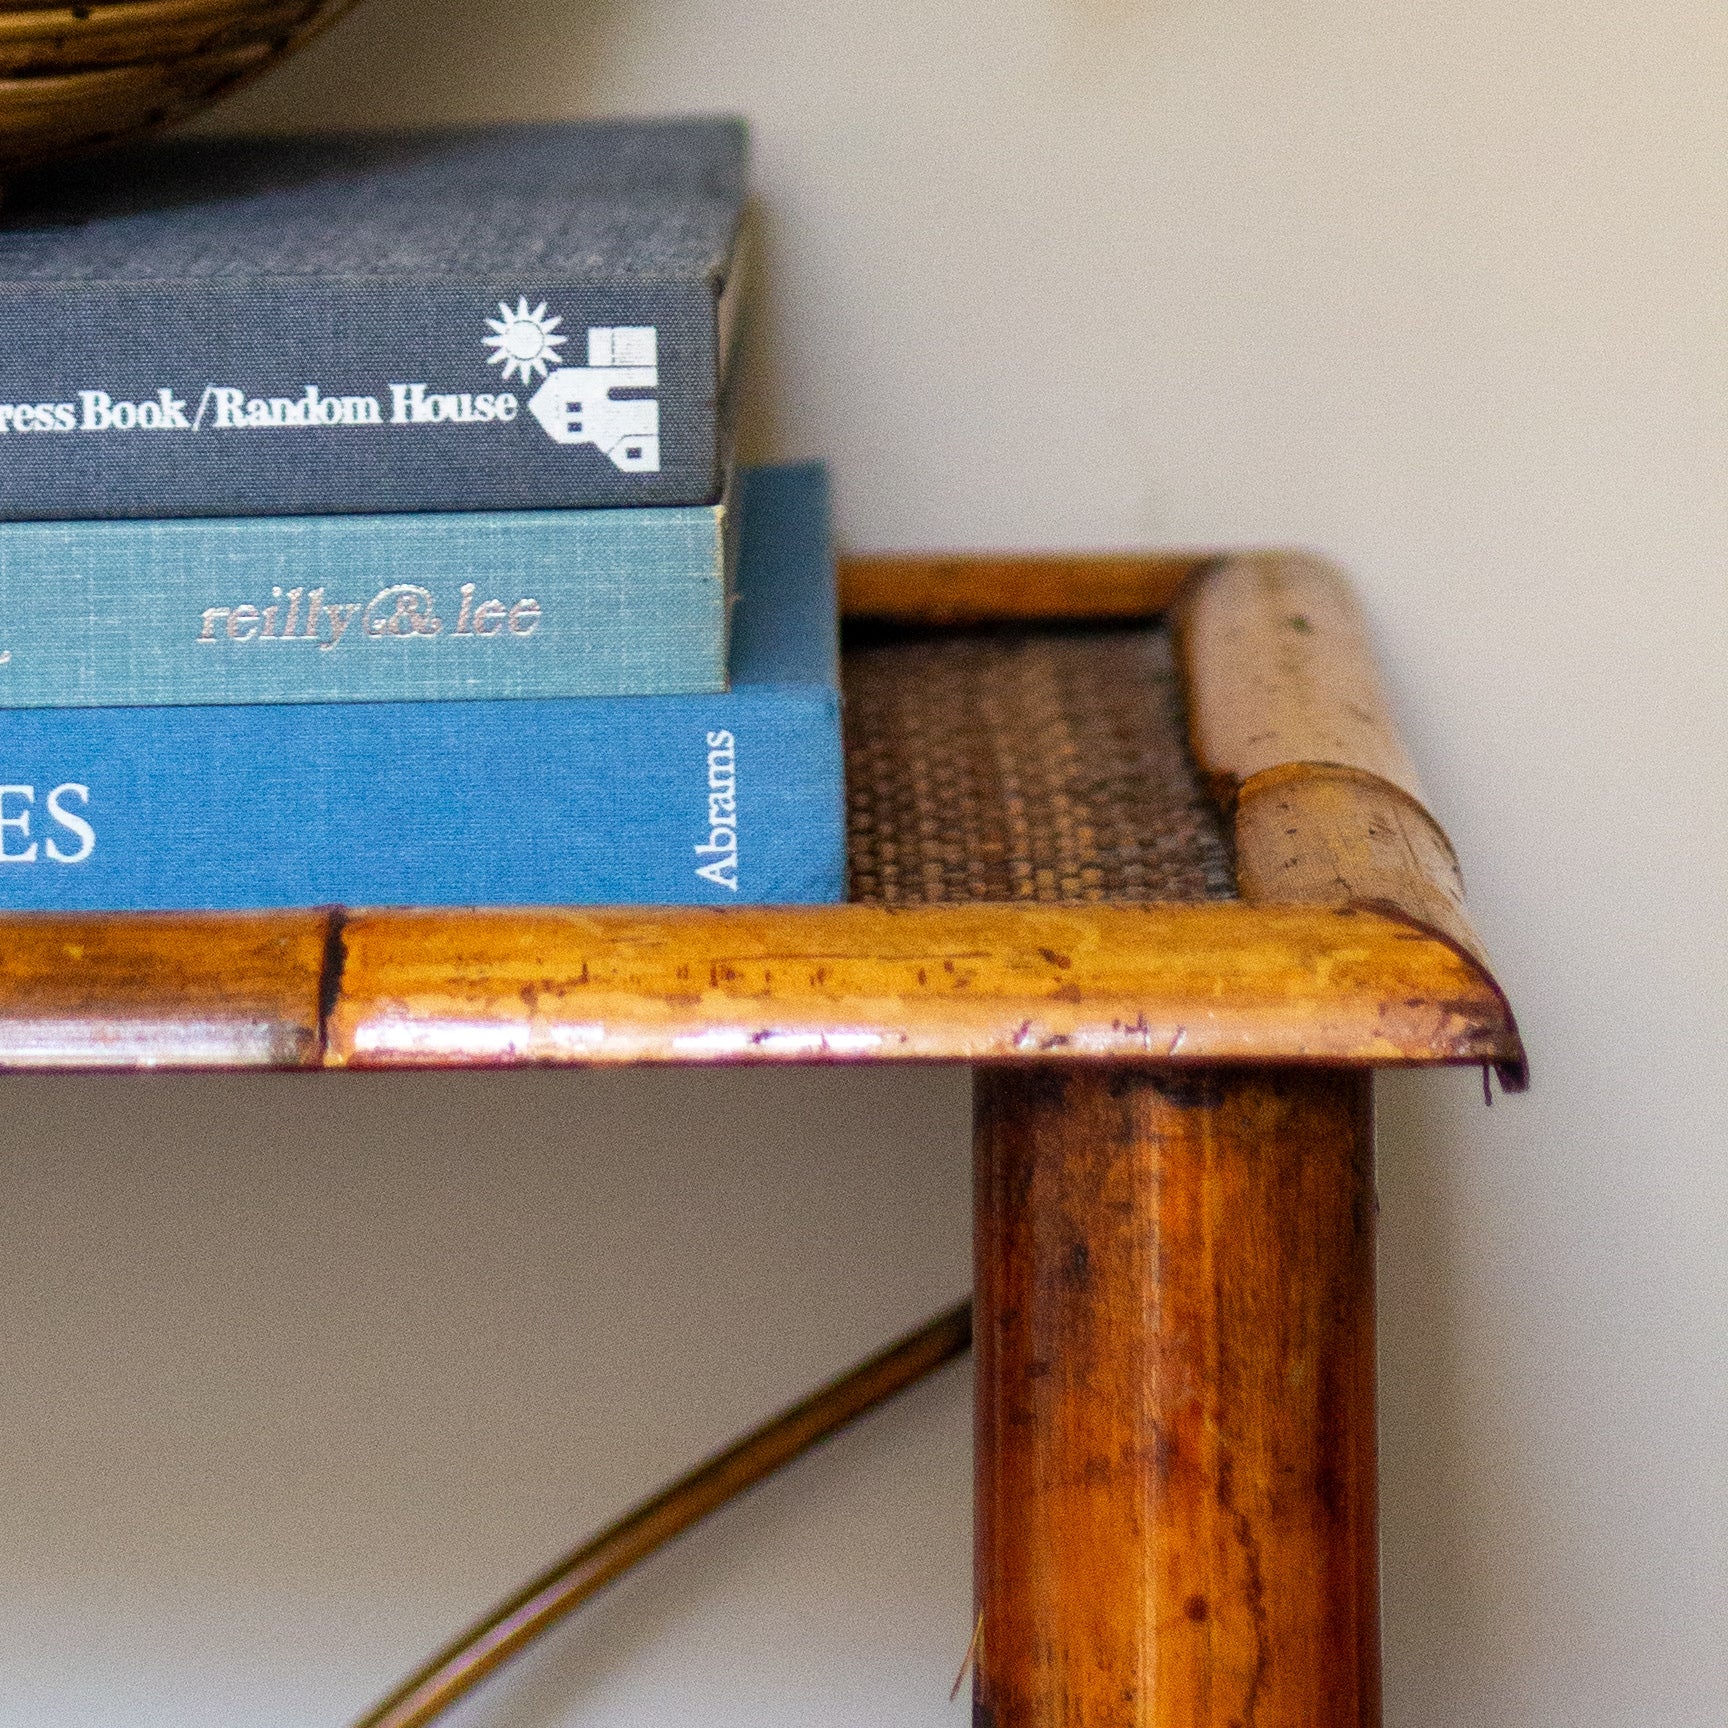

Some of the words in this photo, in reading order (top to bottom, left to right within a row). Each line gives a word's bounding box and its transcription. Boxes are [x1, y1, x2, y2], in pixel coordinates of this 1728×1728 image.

[389, 383, 518, 425] House
[195, 586, 361, 652] reilly
[362, 583, 442, 640] &
[450, 582, 542, 639] lee
[694, 729, 738, 891] Abrams
